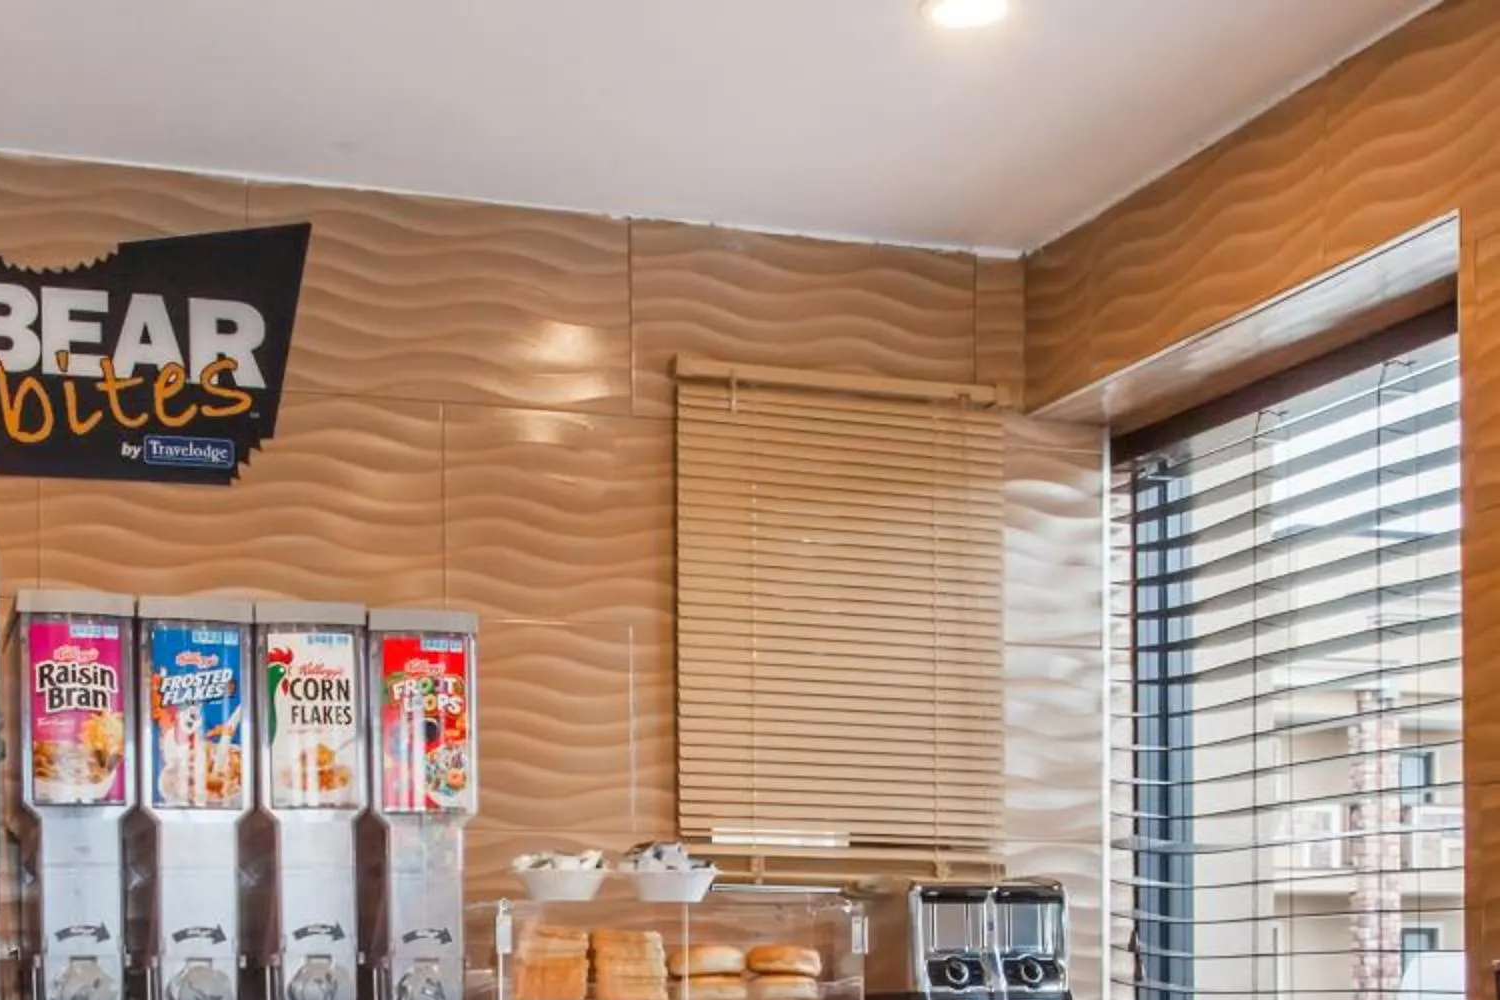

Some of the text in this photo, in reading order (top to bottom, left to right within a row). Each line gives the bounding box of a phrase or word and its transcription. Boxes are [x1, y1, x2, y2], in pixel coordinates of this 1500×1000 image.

[121, 440, 229, 462] by Travelodge
[38, 662, 116, 691] Raisin
[160, 668, 233, 693] FROSTED
[48, 687, 108, 709] Bran
[290, 678, 351, 701] CORN
[291, 705, 352, 725] FLAKES
